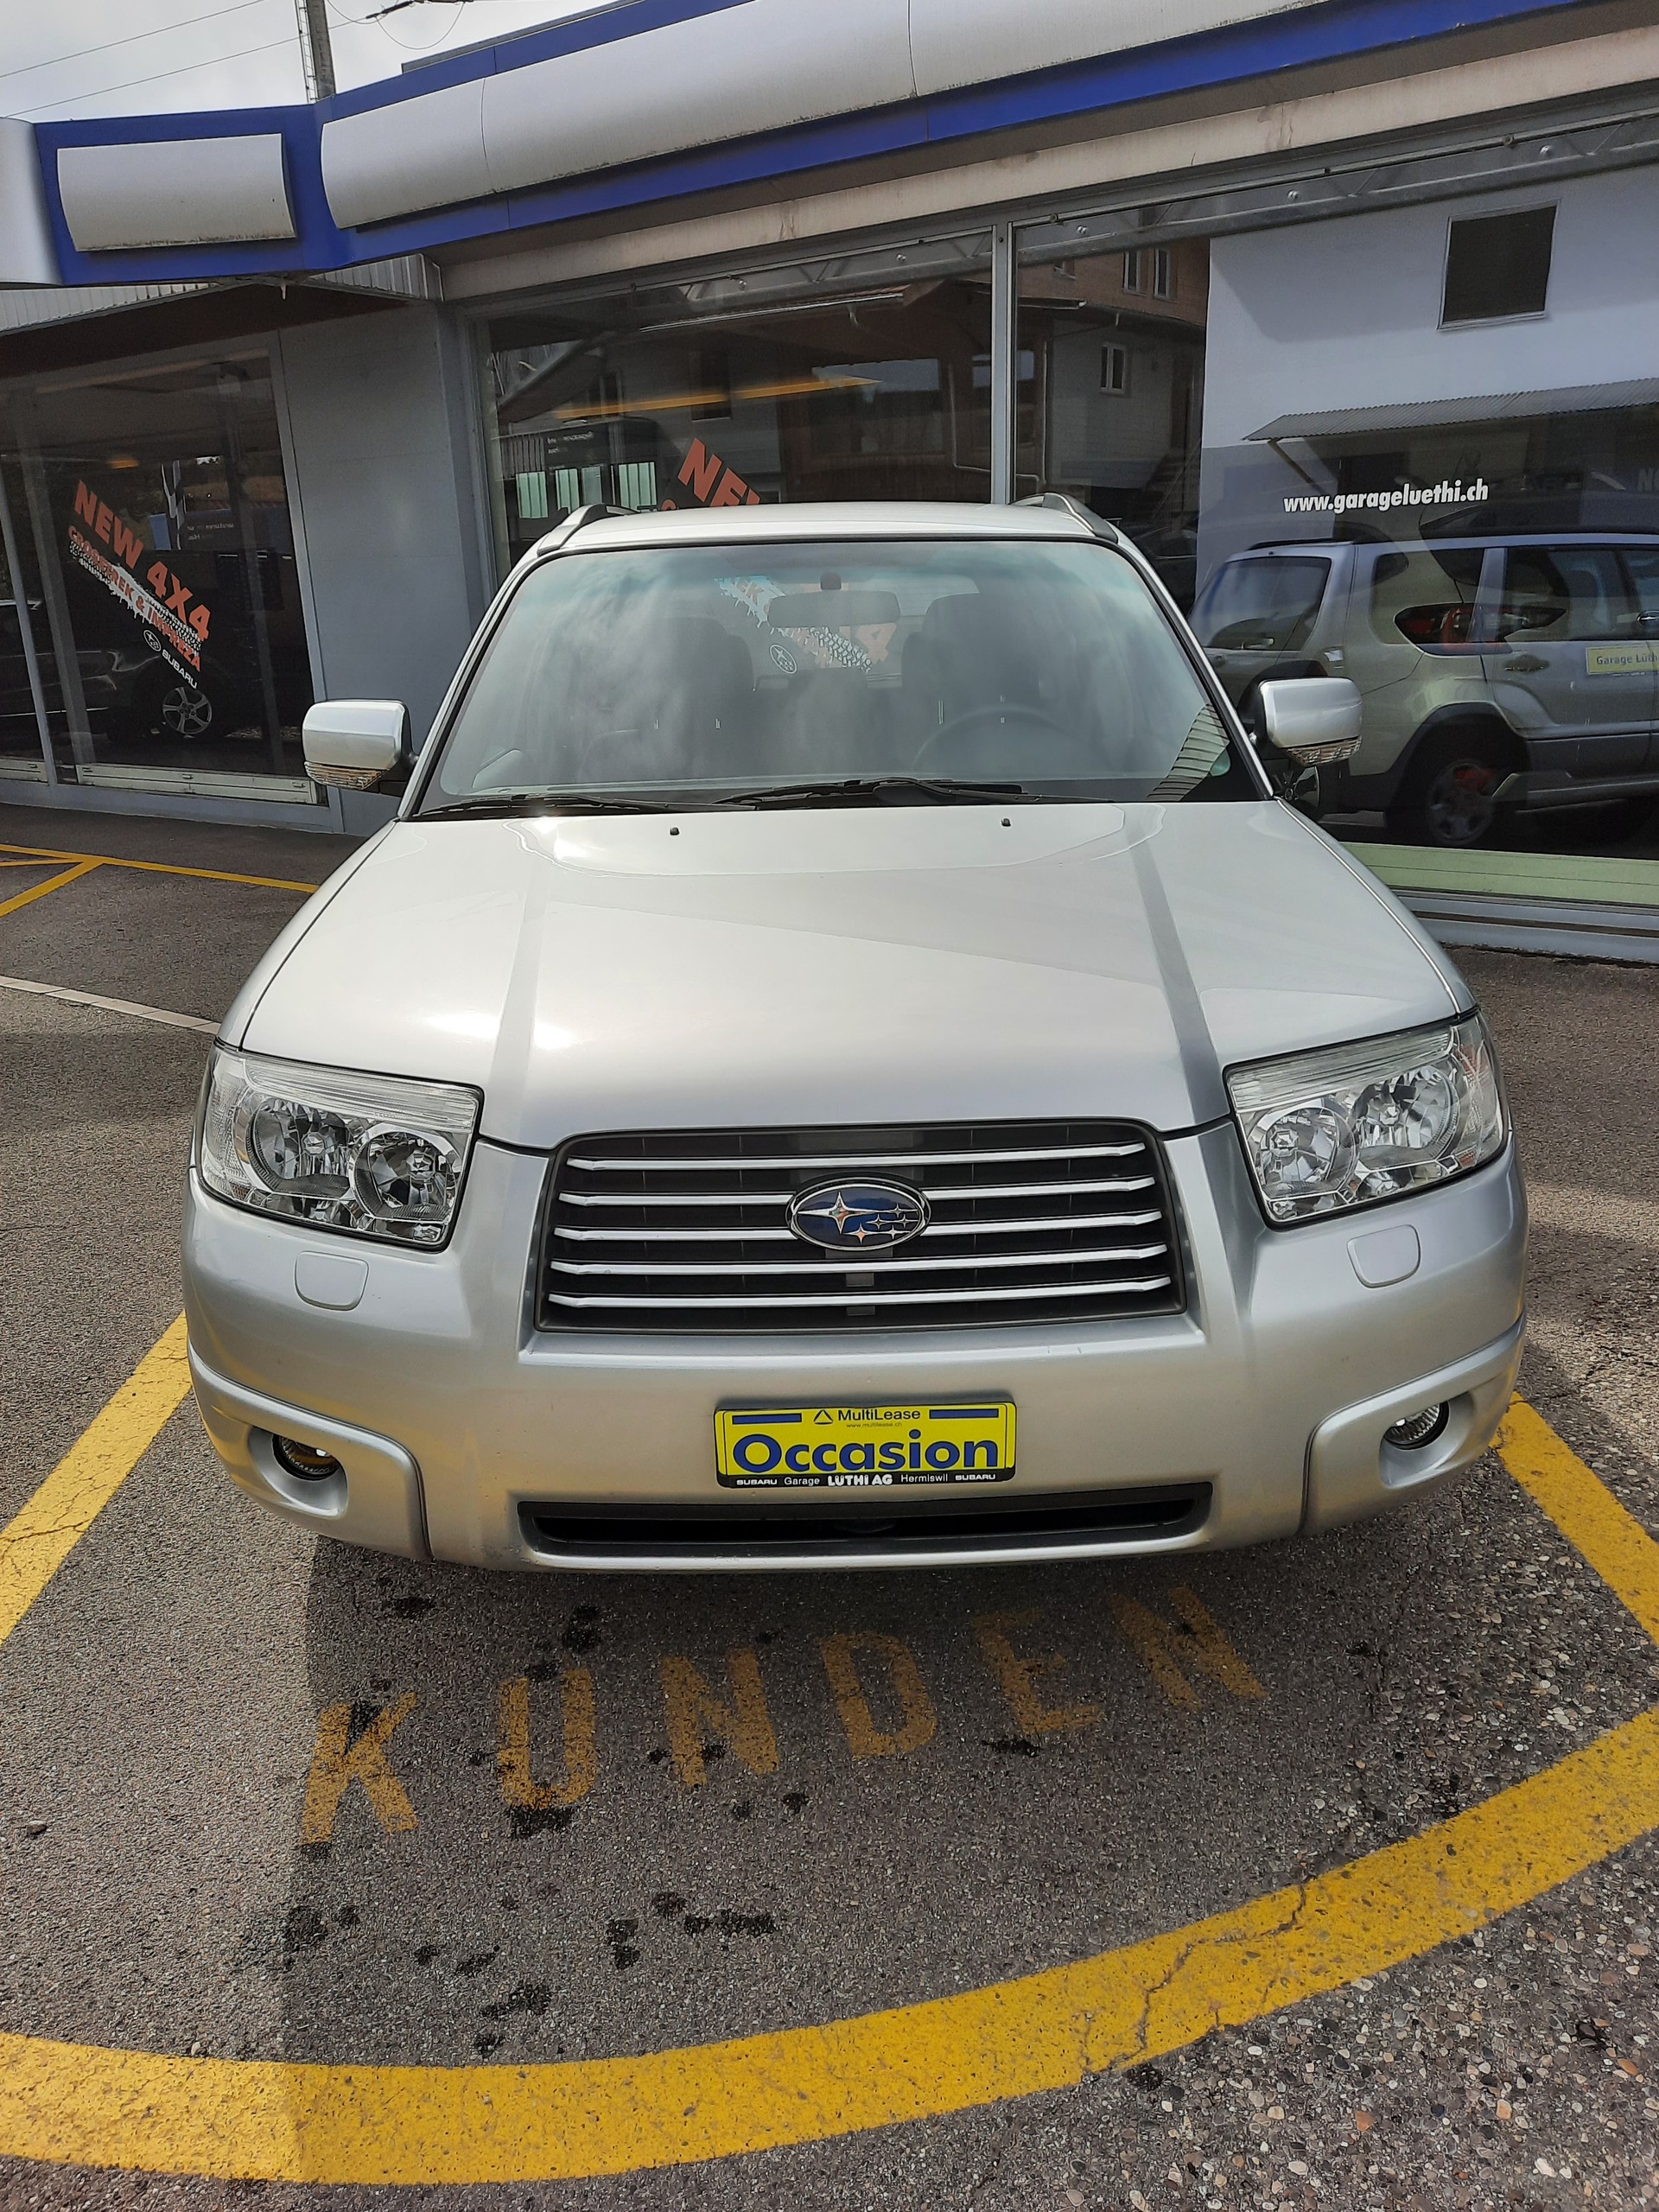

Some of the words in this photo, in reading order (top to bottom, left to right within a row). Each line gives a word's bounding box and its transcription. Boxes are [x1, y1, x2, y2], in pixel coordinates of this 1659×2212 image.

[1284, 478, 1489, 513] www.garageluethi.ch
[74, 480, 144, 570] NEW
[148, 607, 201, 672] IMPREZA
[162, 649, 198, 689] SUBARU
[1596, 656, 1633, 665] Garage
[838, 1409, 921, 1421] MultiLease
[734, 1428, 998, 1472] Occasion
[784, 1477, 820, 1486] Garage
[871, 1474, 893, 1485] AG
[301, 1585, 1265, 1846] KUNDEN
